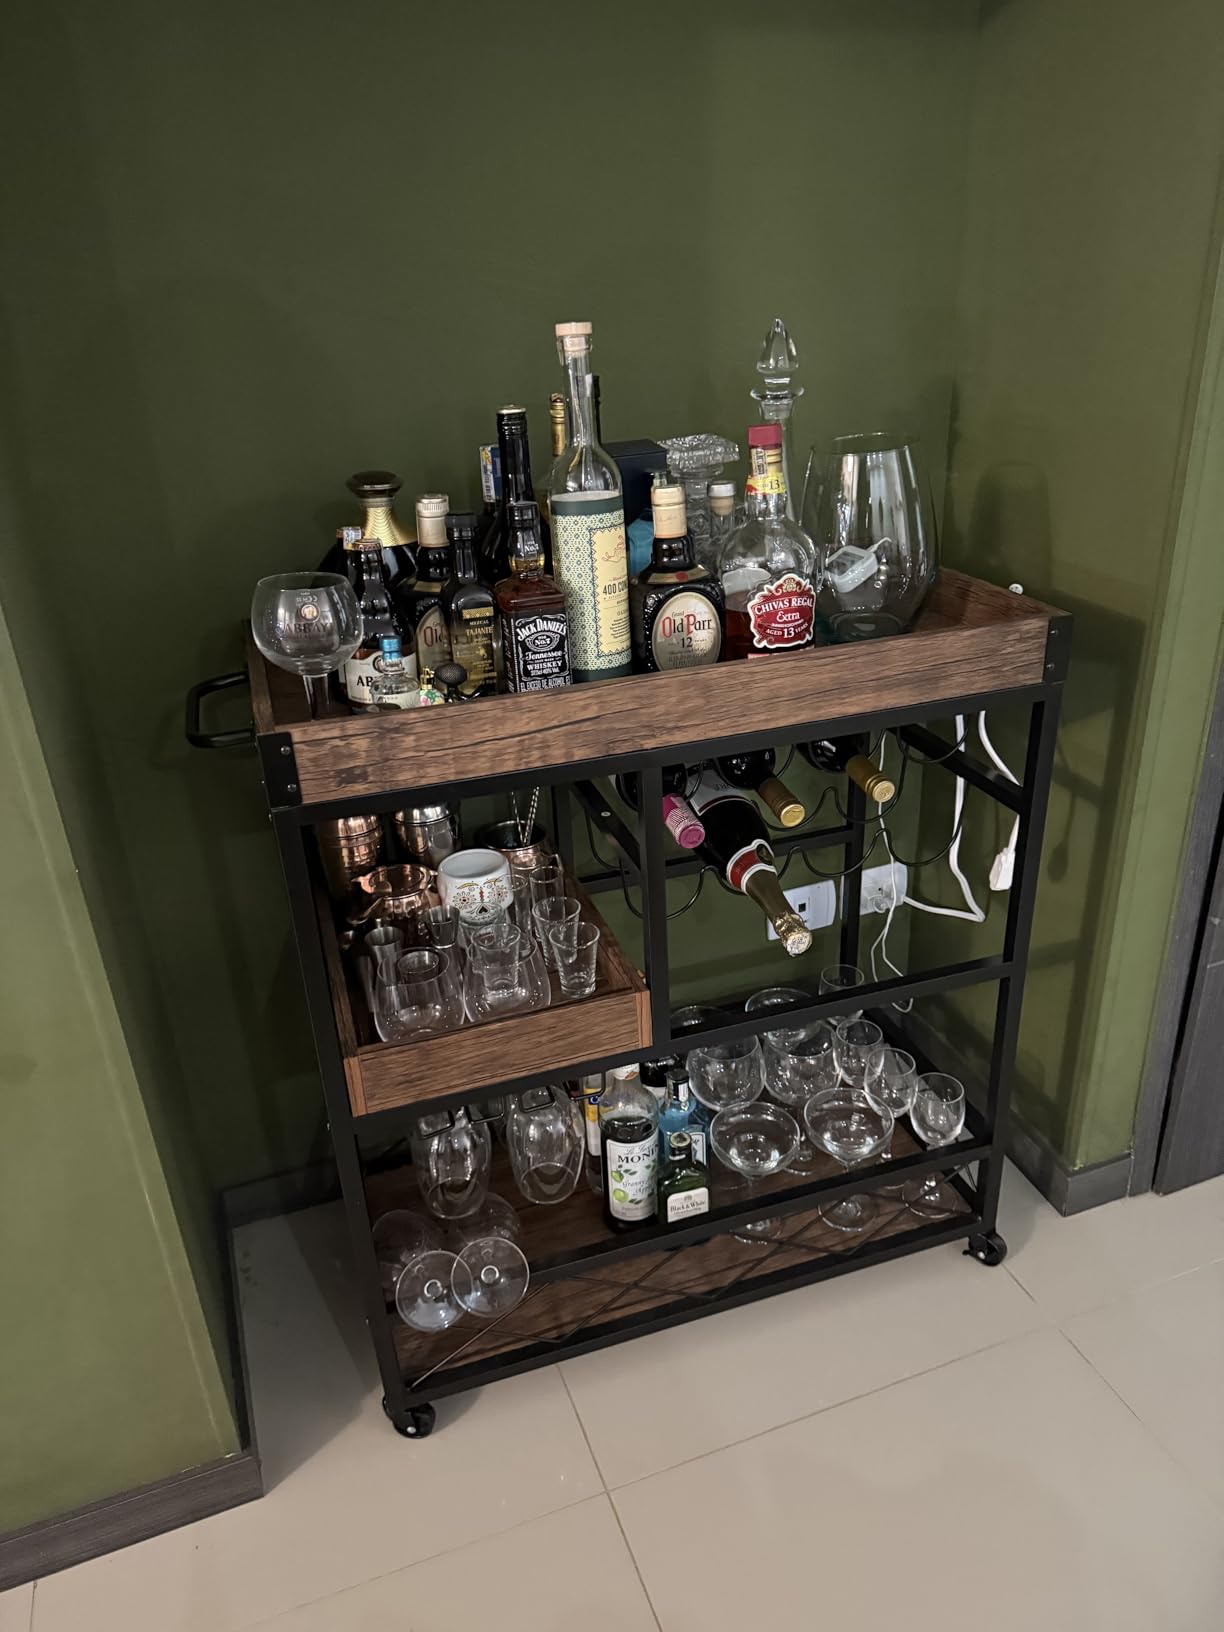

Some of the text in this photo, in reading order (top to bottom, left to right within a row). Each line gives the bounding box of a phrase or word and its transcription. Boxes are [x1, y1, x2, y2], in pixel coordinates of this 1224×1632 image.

[769, 480, 780, 489] 13
[603, 583, 617, 596] 400
[755, 597, 813, 615] CHIVAS REGAL
[776, 611, 800, 622] Extra
[516, 618, 568, 641] JACK DANIEL'S
[662, 613, 712, 638] Old Parr
[766, 628, 783, 636] AGED
[784, 628, 795, 638] 13
[534, 638, 551, 646] No.7
[681, 637, 693, 648] 12
[525, 651, 563, 660] Tennessee
[527, 660, 562, 671] WHISKEY
